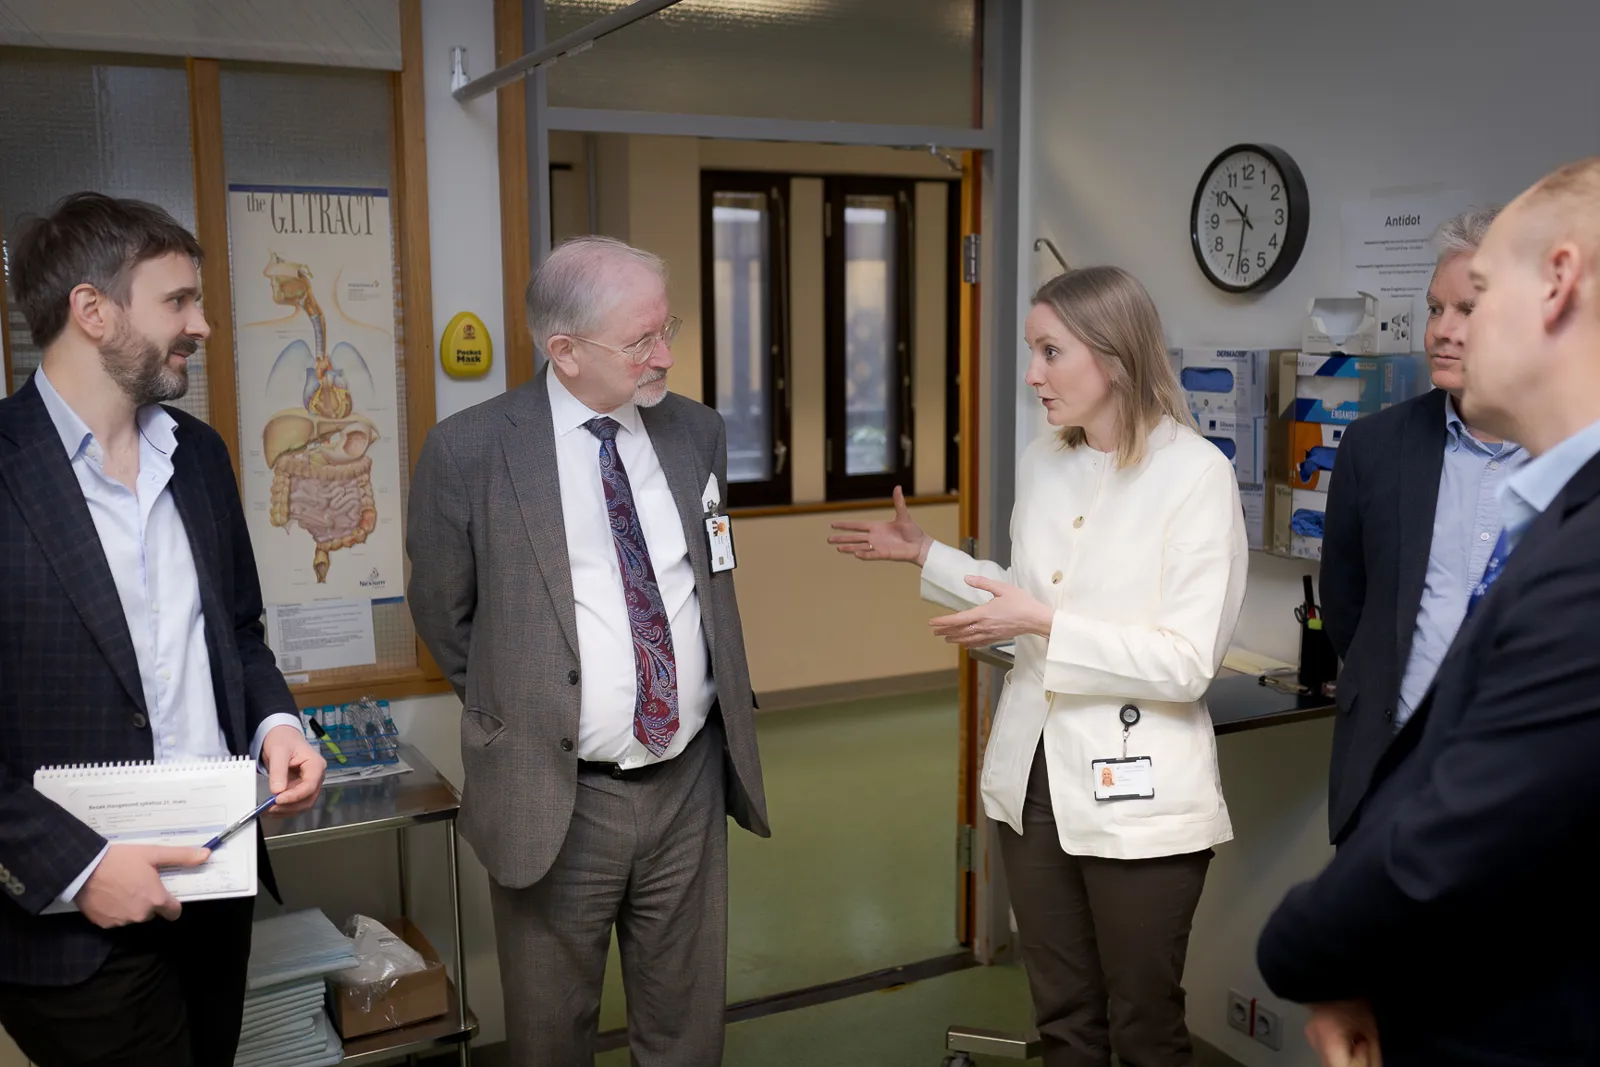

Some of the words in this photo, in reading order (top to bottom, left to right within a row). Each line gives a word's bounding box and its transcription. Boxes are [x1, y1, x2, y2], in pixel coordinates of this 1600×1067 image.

[1227, 172, 1237, 188] 11
[1242, 164, 1254, 181] 12
[1261, 169, 1266, 185] 1
[1216, 190, 1229, 207] 10
[1270, 184, 1280, 201] 2
[246, 192, 266, 213] the
[1210, 213, 1220, 229] 9
[1274, 208, 1284, 225] 3
[1385, 214, 1421, 227] Antidot
[1214, 236, 1224, 252] 8
[1268, 233, 1278, 250] 4
[1226, 254, 1235, 269] 7
[1240, 258, 1250, 274] 6
[1256, 252, 1266, 268] 5
[456, 355, 481, 363] Mask
